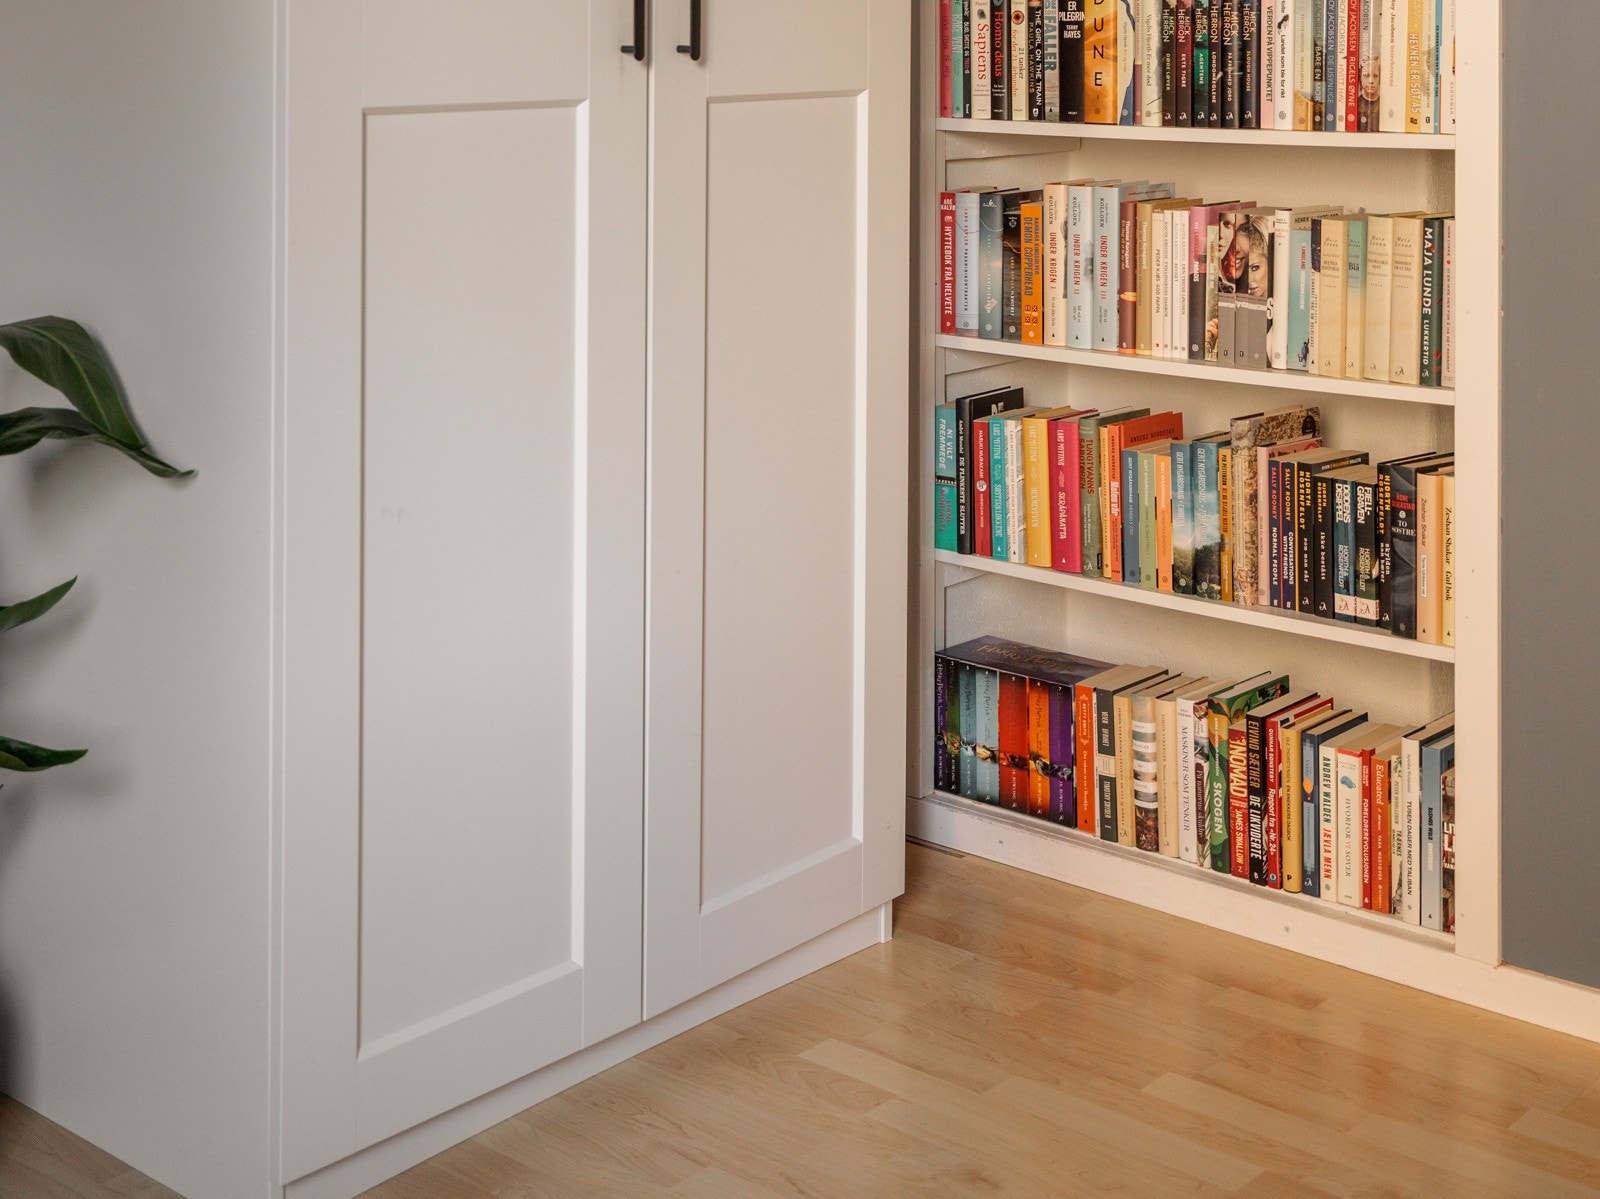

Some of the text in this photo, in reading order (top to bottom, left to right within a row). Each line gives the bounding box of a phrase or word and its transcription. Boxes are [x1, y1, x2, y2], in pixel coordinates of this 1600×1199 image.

[1068, 0, 1076, 11] ER
[974, 23, 989, 80] Sapiens
[994, 11, 1005, 77] Homo deus
[1036, 49, 1042, 61] ON
[1045, 15, 1057, 71] FALLER
[1064, 30, 1081, 39] HAYES
[1266, 36, 1274, 46] PÅ
[1409, 34, 1420, 100] HEVNEN ER SØT
[1024, 217, 1033, 296] DEMON COPPERHEAD
[1424, 228, 1433, 266] MAJA
[944, 267, 953, 280] FRÅ
[1423, 270, 1432, 315] LUNDE
[947, 429, 952, 439] NI
[959, 457, 965, 466] DE
[1181, 725, 1189, 772] MASKINER
[1229, 745, 1246, 797] NOMAD
[1248, 721, 1262, 859] EIVIND SÆTHER DE LIKVIDERTE
[1267, 788, 1276, 816] Rapport
[1375, 764, 1384, 804] Educated
[1213, 782, 1223, 833] SKOGEN
[1322, 757, 1332, 879] ANDREV WALDEN JÆVLA MENN
[1234, 809, 1243, 863] JAMES SWALLOW
